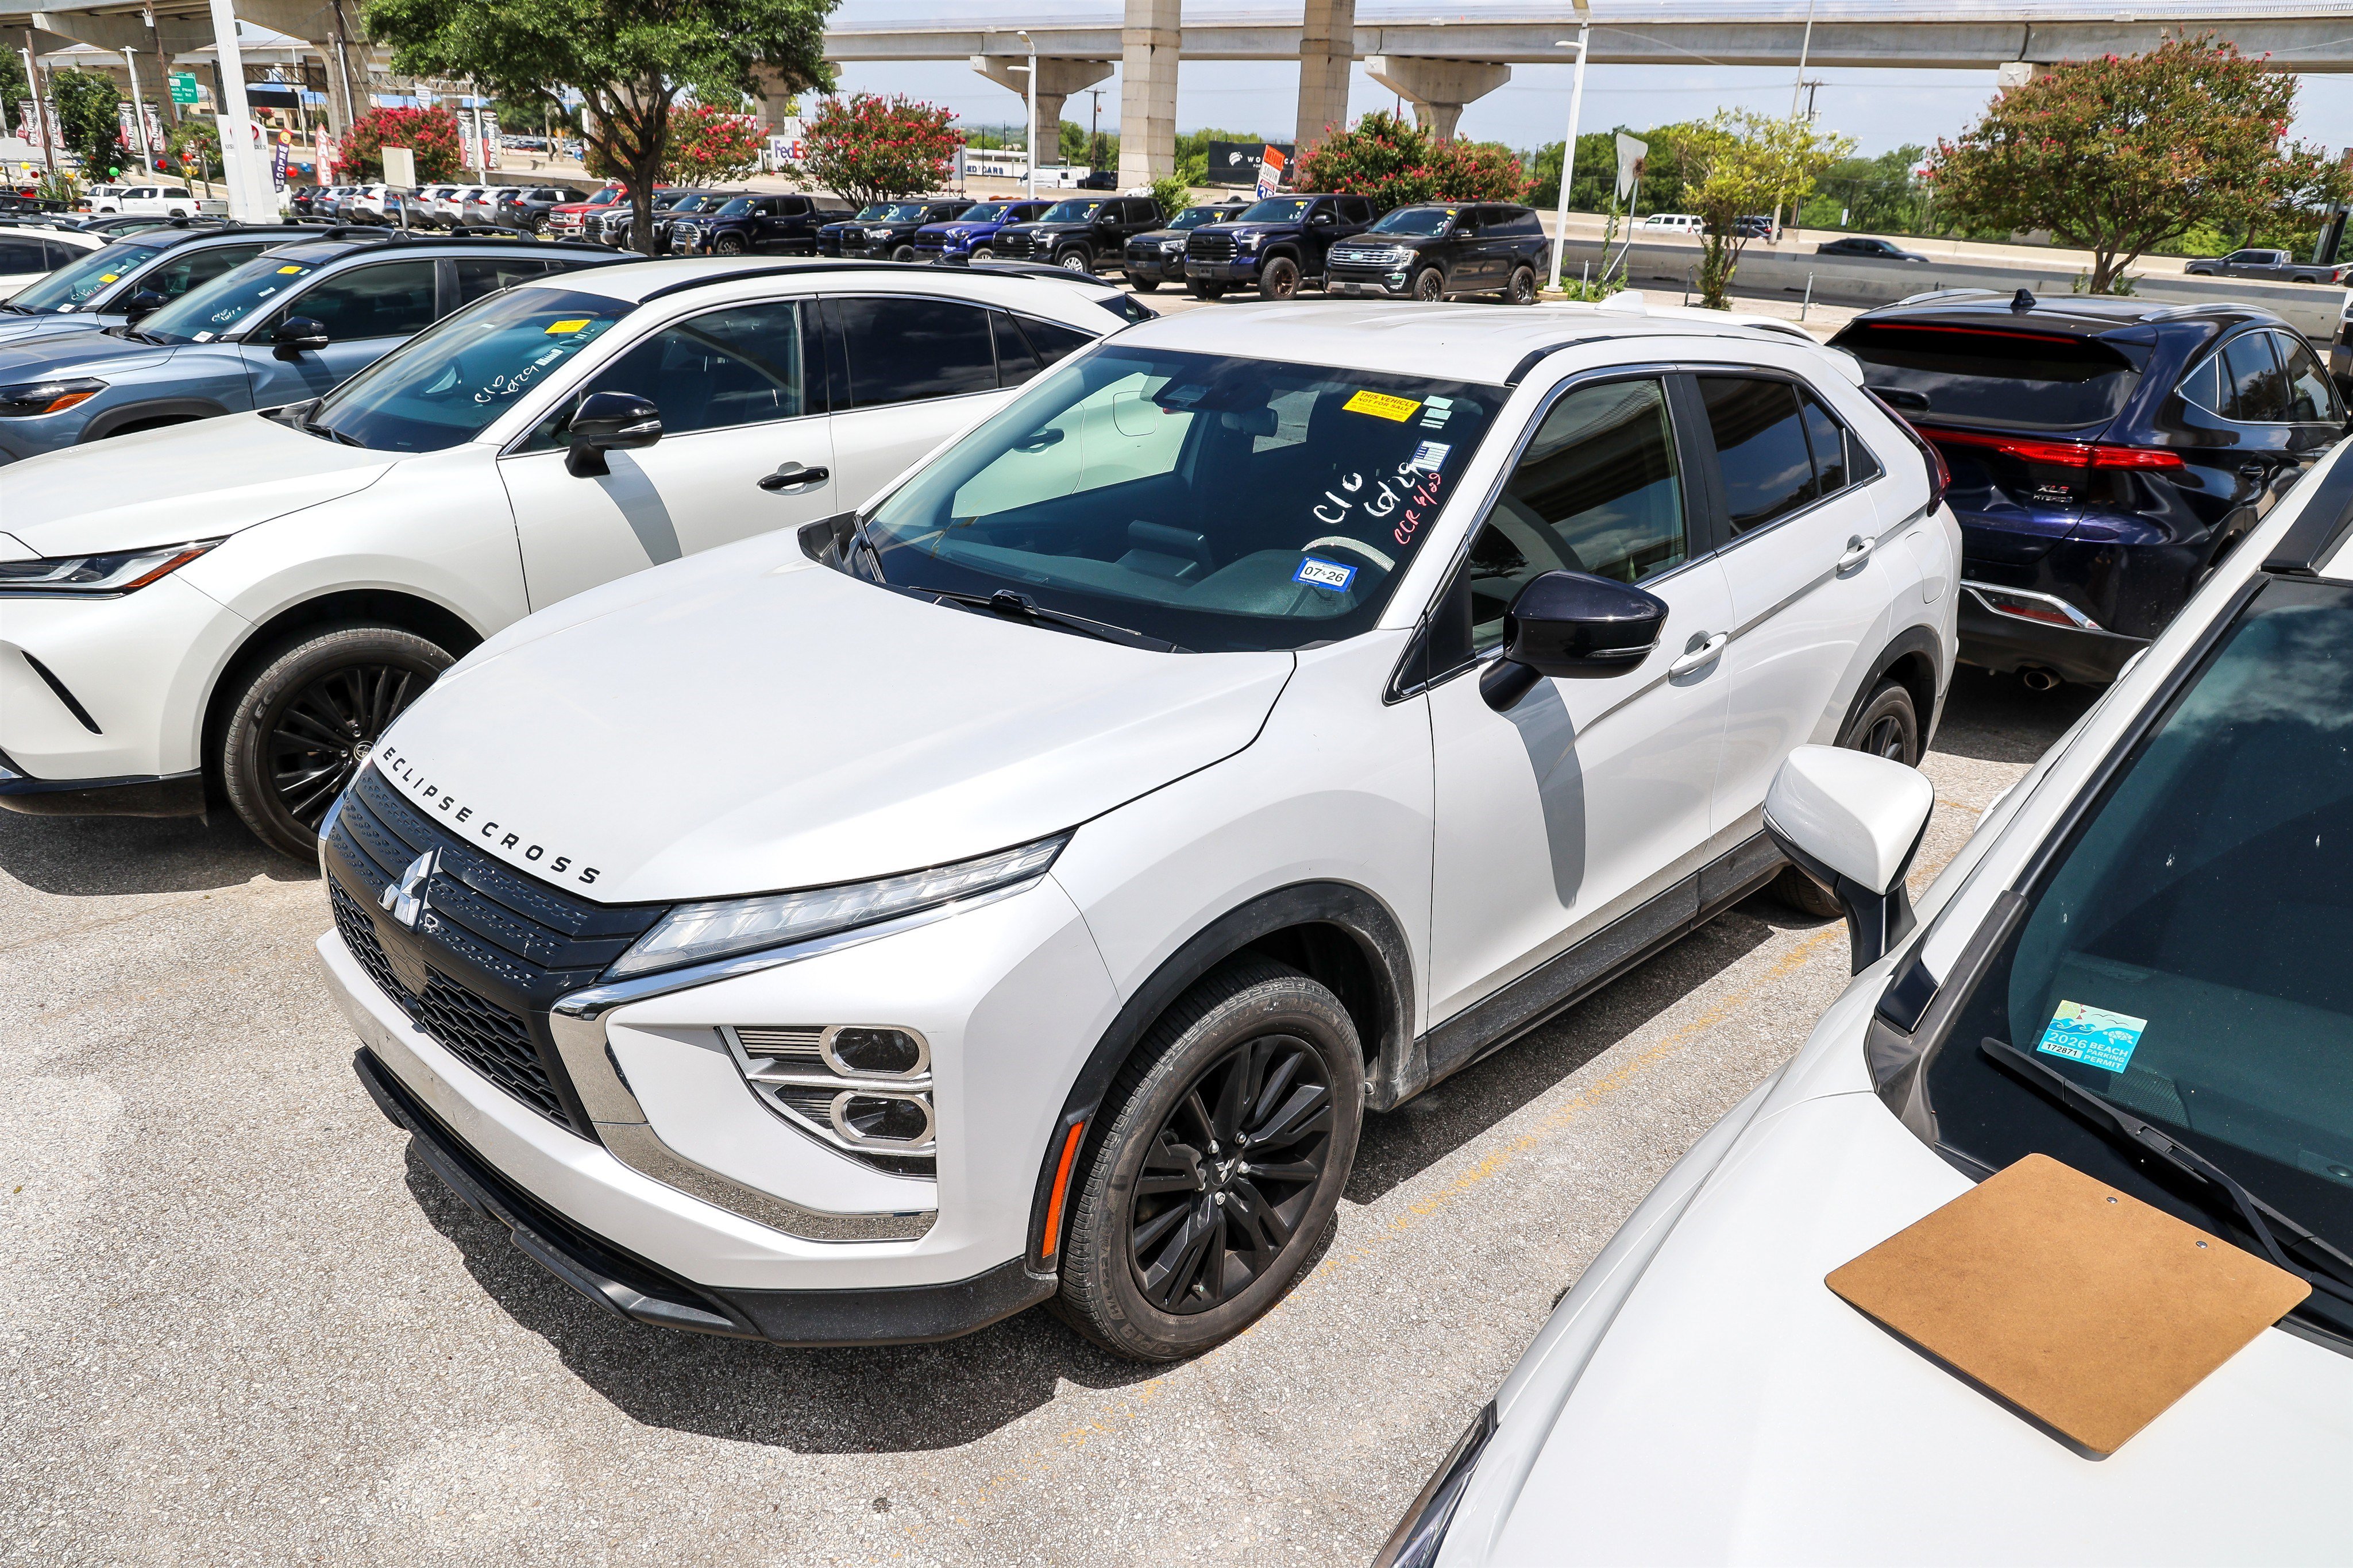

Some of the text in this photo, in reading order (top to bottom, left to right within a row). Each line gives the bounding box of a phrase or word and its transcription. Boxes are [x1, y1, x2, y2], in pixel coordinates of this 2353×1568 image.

[23, 107, 35, 133] Owned
[122, 111, 134, 138] Owned
[147, 113, 159, 139] Owned
[128, 138, 137, 150] Pre
[153, 138, 162, 151] Pre
[461, 121, 473, 152] Owned
[484, 122, 497, 152] Owned
[318, 129, 333, 186] SALE
[465, 153, 475, 168] Pre
[488, 153, 498, 168] Pre
[982, 165, 1004, 175] CARS
[1263, 165, 1279, 181] SOUTH
[1380, 396, 1417, 408] VEHICLE
[2037, 485, 2069, 493] XLE
[1394, 509, 1421, 544] CCR
[1305, 566, 1322, 577] 07
[1326, 571, 1344, 582] 26
[382, 747, 601, 885] ECLIPSE CROSS
[2048, 1032, 2088, 1049] 2026
[2046, 1043, 2078, 1056] 172871
[2086, 1049, 2125, 1063] PARKING
[2089, 1041, 2129, 1057] BEACH
[2083, 1055, 2123, 1069] PERMIT
